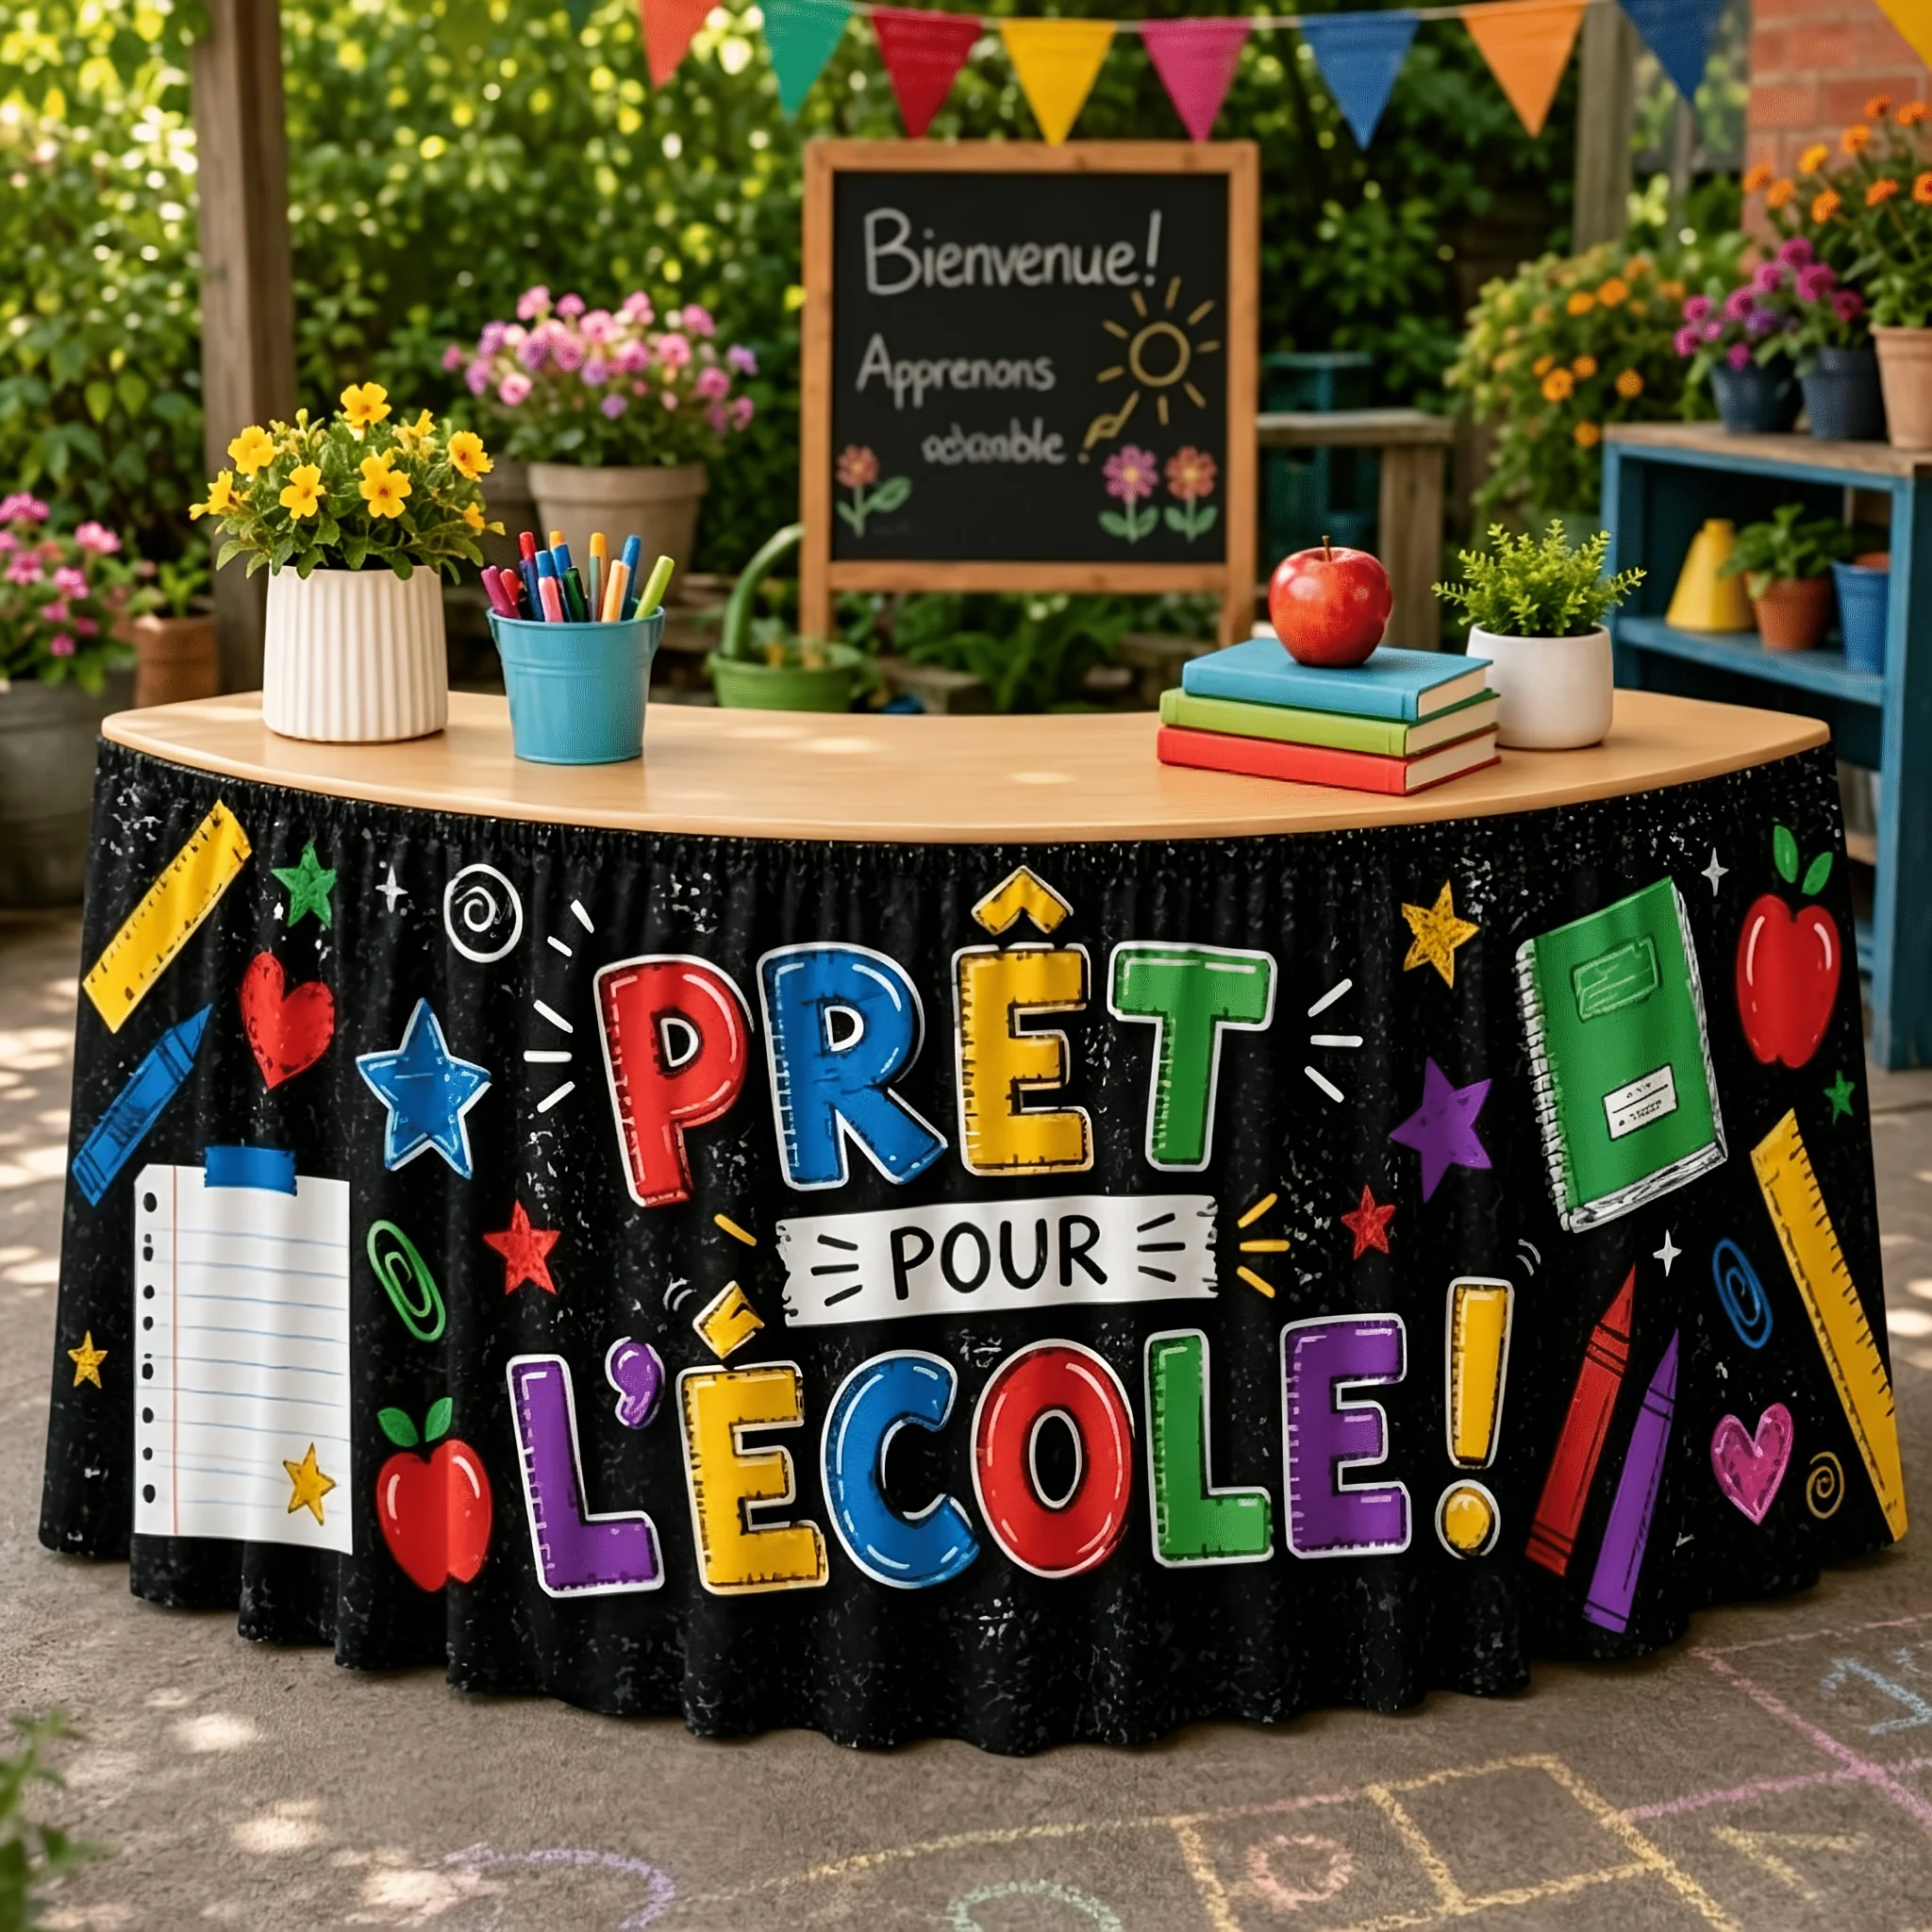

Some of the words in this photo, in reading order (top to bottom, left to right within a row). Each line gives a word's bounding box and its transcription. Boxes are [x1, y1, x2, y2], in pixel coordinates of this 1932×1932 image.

[863, 208, 1162, 295] Bienvenue!
[856, 333, 1056, 408] Apprenons
[593, 866, 1277, 1208] PRÊT
[890, 1215, 1108, 1301] POUR
